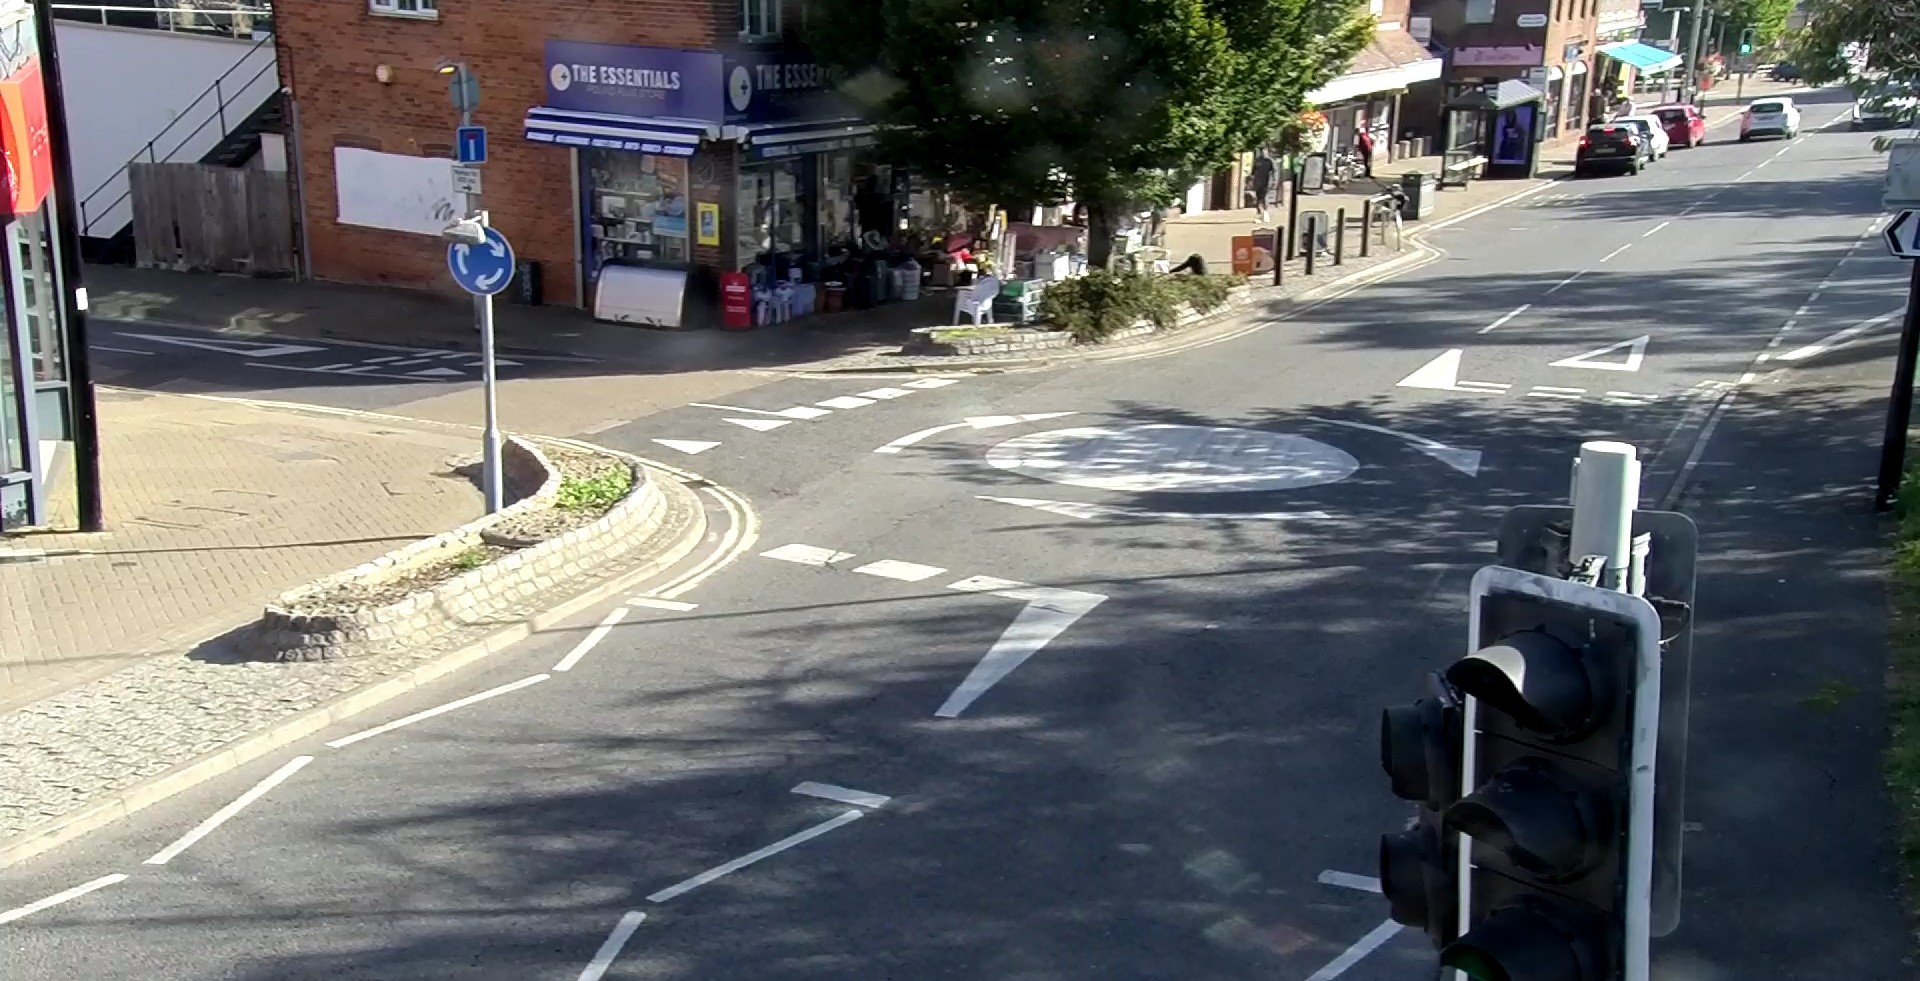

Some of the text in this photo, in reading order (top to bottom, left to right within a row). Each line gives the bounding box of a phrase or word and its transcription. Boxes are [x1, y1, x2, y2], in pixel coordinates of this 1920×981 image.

[572, 64, 680, 90] THE ESSENTIALS
[756, 64, 781, 90] THE
